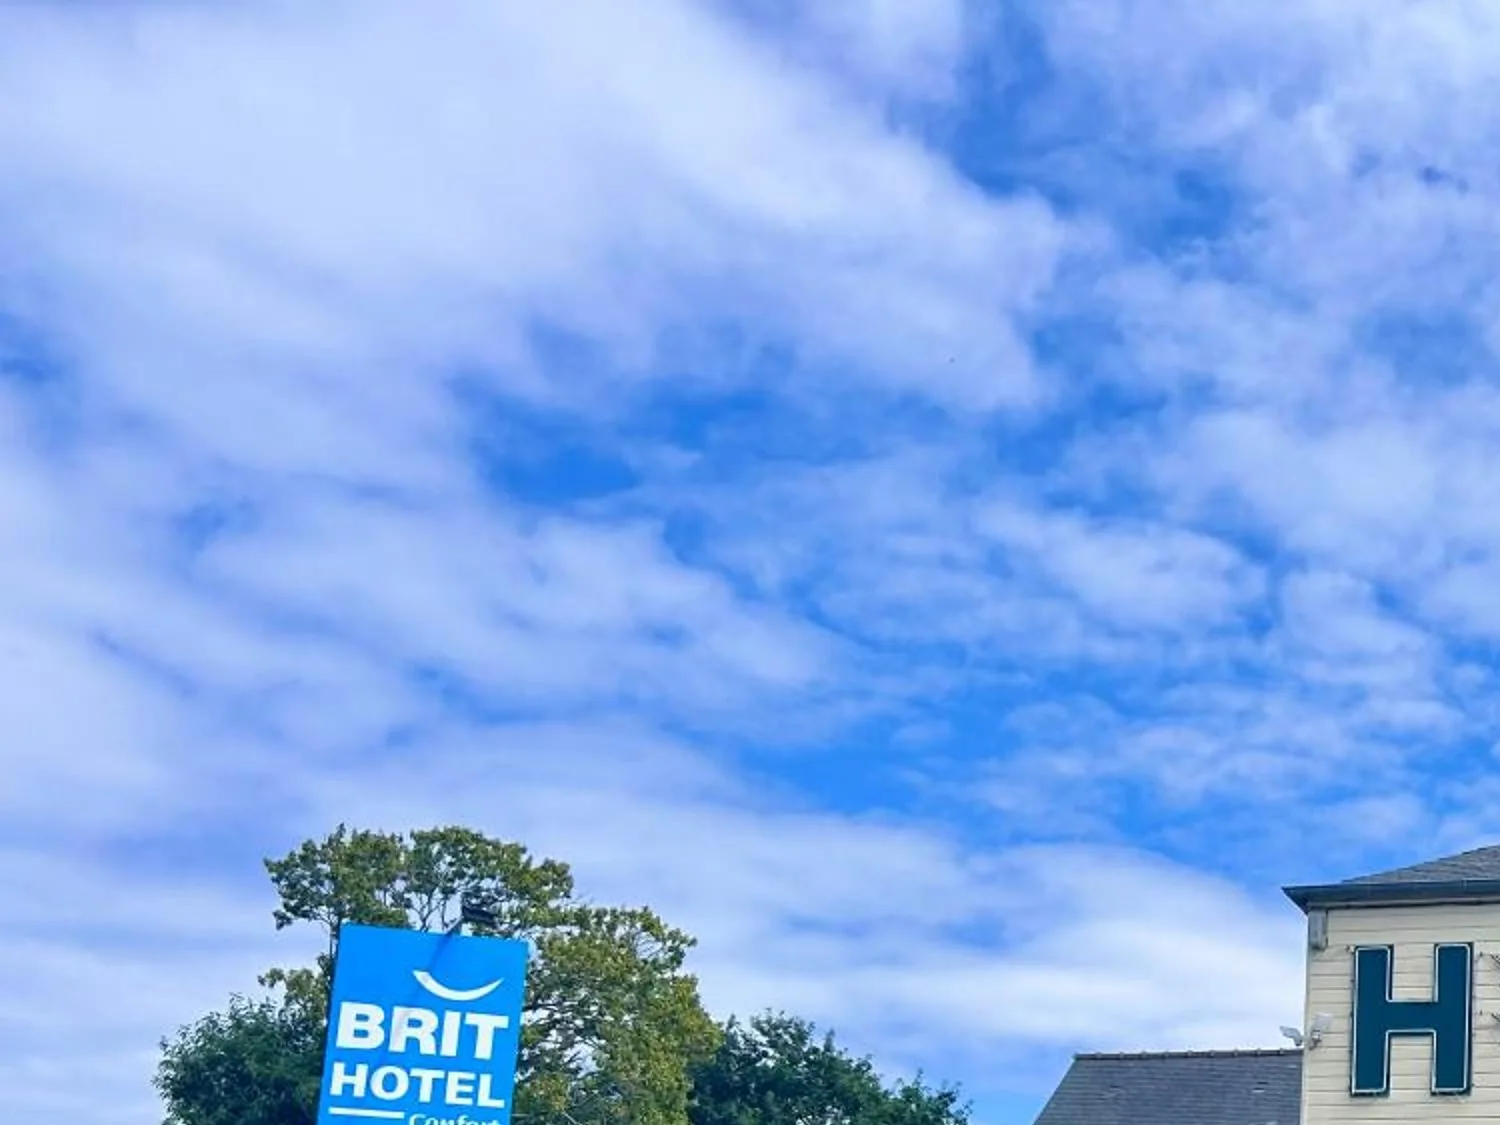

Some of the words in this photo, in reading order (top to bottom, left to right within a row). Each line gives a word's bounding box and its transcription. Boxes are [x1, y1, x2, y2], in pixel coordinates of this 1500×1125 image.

[336, 1001, 509, 1060] BRIT
[1352, 942, 1473, 1096] H
[329, 1061, 505, 1108] HOTEL
